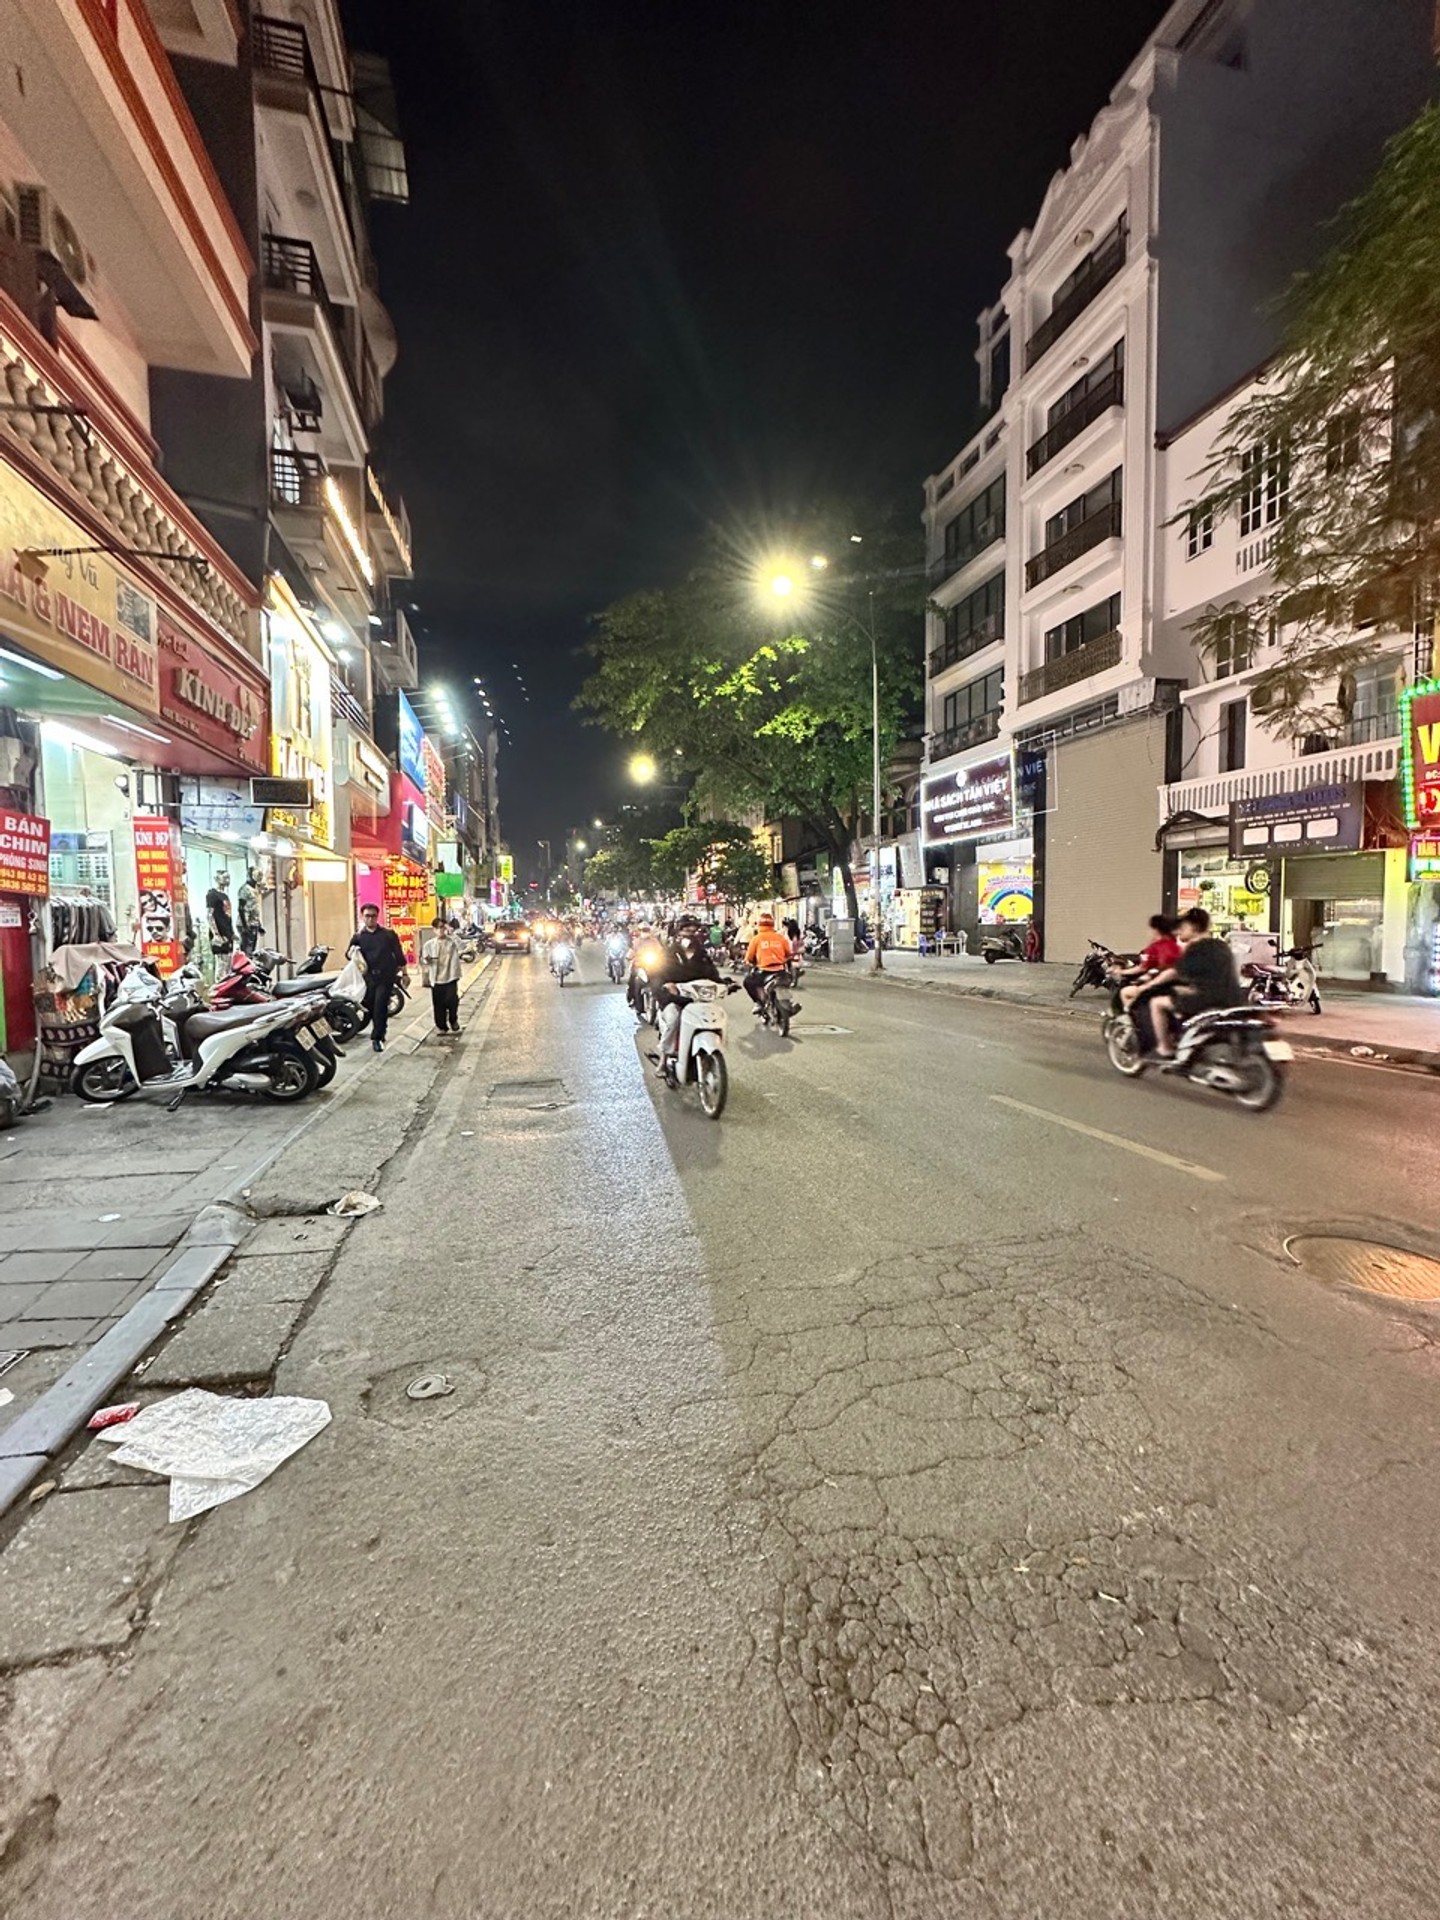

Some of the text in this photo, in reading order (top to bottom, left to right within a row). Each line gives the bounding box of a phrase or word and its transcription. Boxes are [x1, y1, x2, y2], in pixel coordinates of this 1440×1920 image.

[57, 591, 111, 663] NEM
[177, 667, 226, 723] KÍNH
[0, 833, 48, 856] CHIM
[4, 816, 44, 838] BÁN
